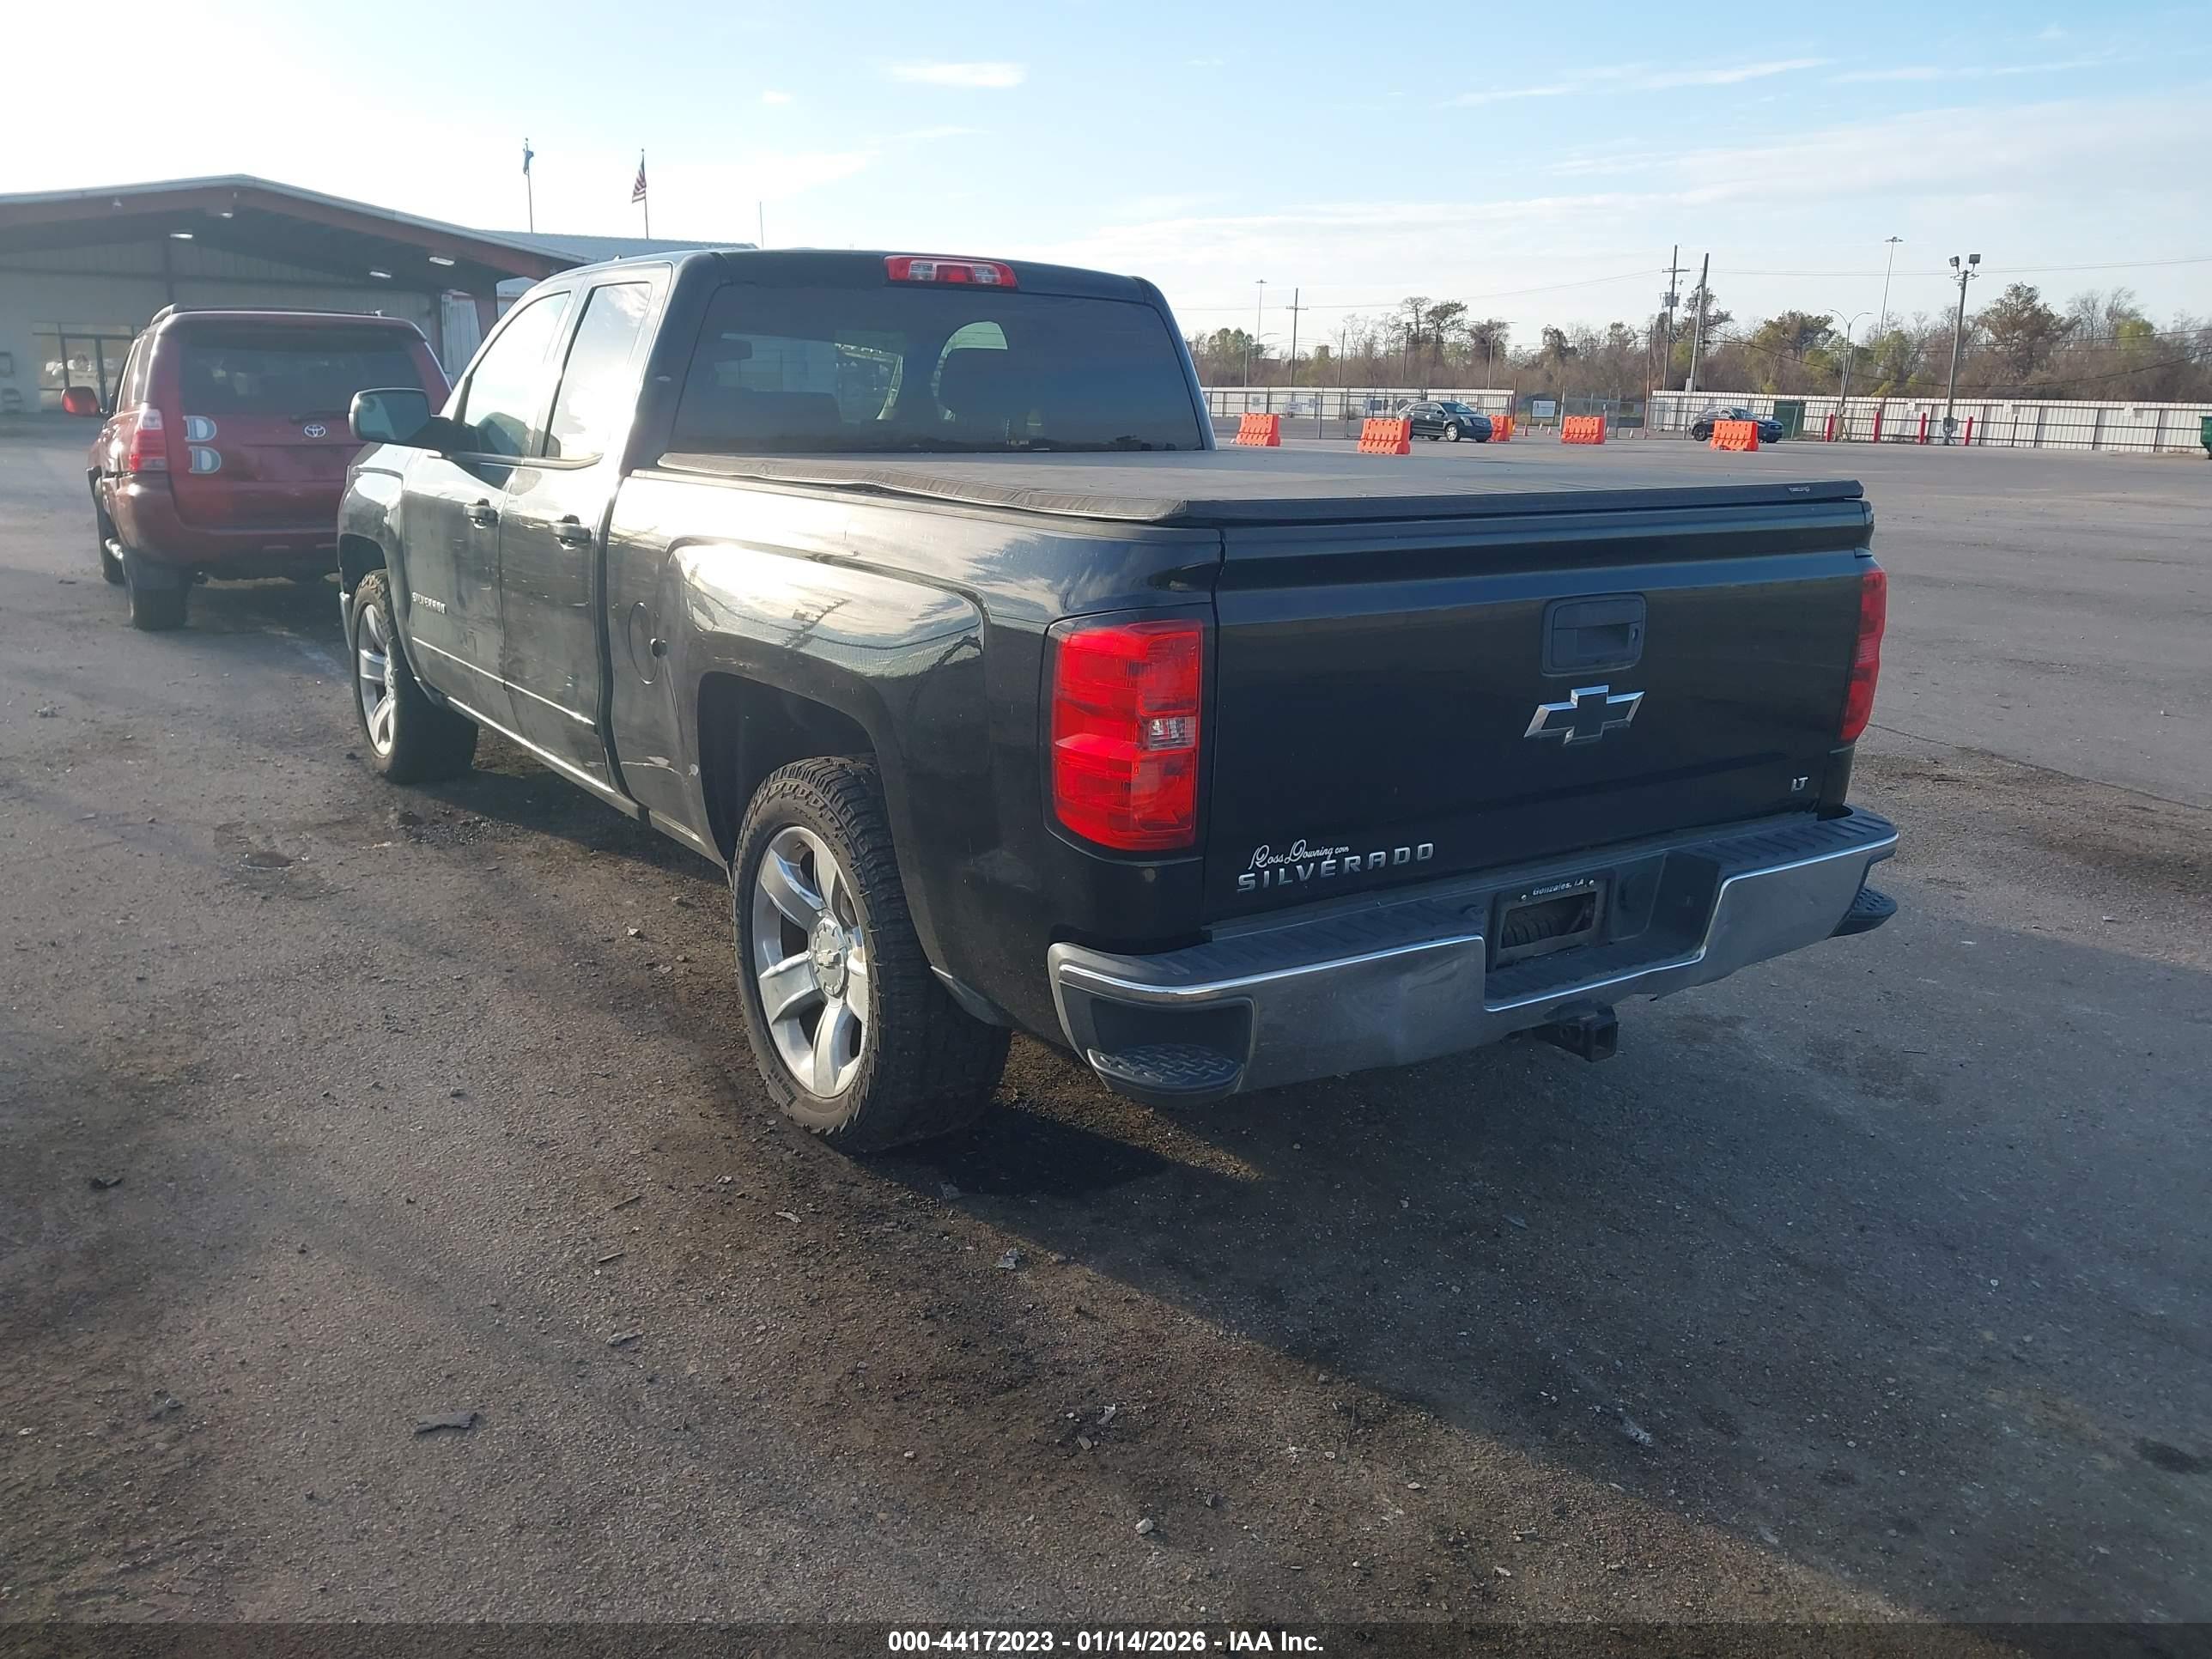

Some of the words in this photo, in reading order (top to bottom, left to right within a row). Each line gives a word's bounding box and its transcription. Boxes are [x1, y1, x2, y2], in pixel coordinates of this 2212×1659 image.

[183, 416, 217, 442] D
[188, 446, 222, 474] D
[1237, 842, 1434, 892] SILVERADO
